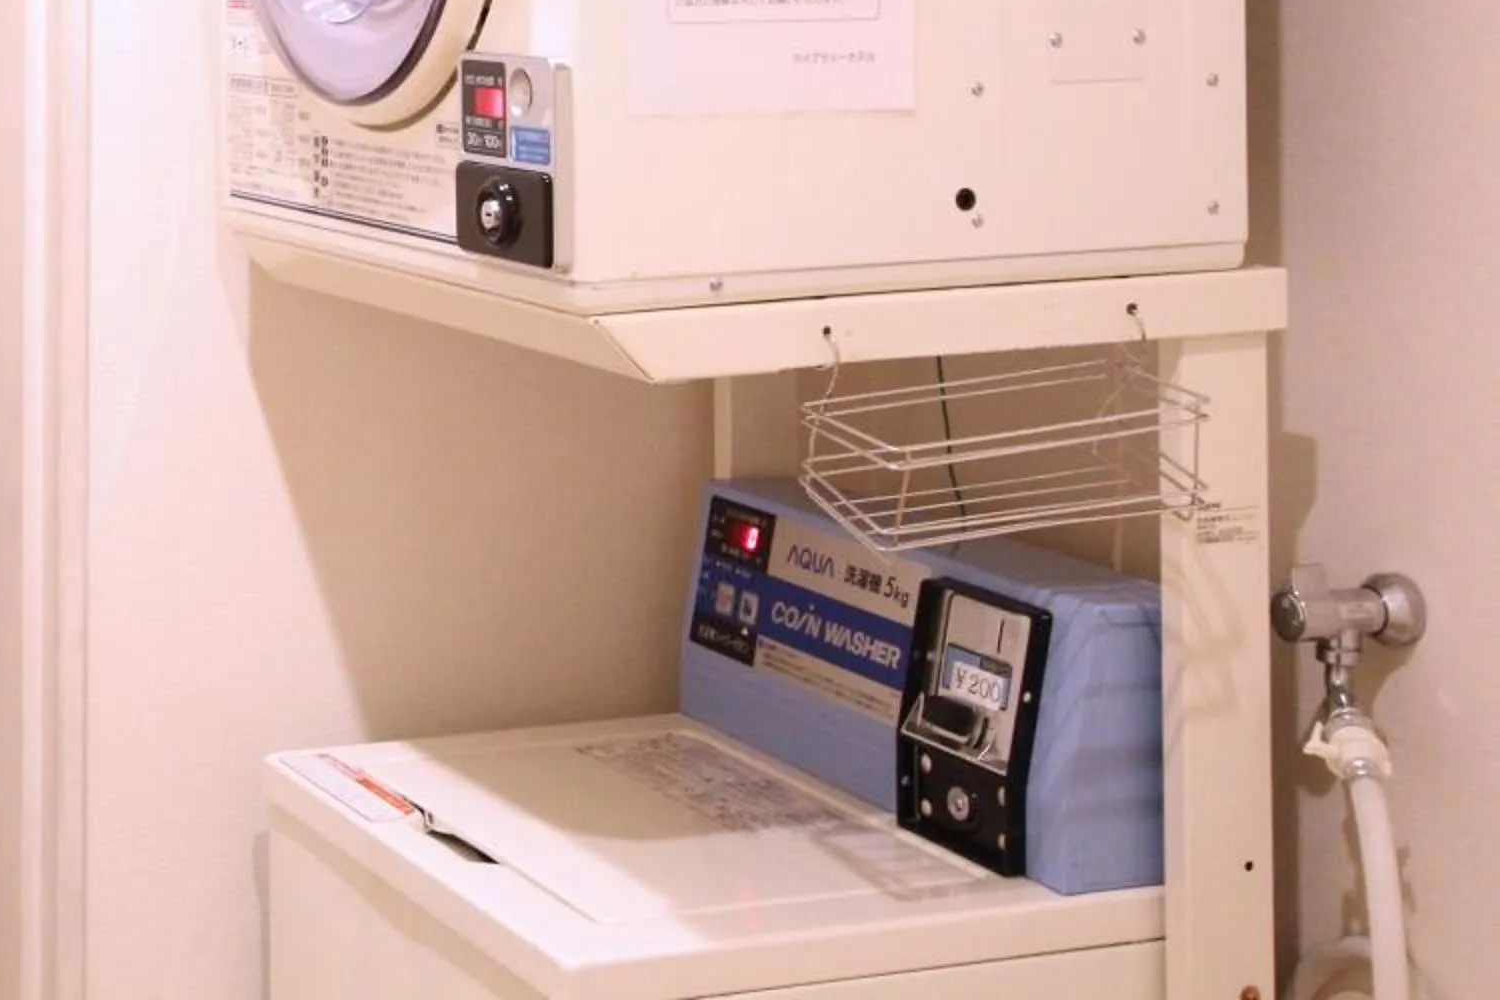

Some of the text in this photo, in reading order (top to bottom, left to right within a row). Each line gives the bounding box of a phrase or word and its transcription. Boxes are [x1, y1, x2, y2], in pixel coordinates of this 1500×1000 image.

[785, 544, 911, 609] AQUA 洗濯機 5kg
[823, 619, 902, 671] WASHER
[956, 667, 1001, 702] ¥200
